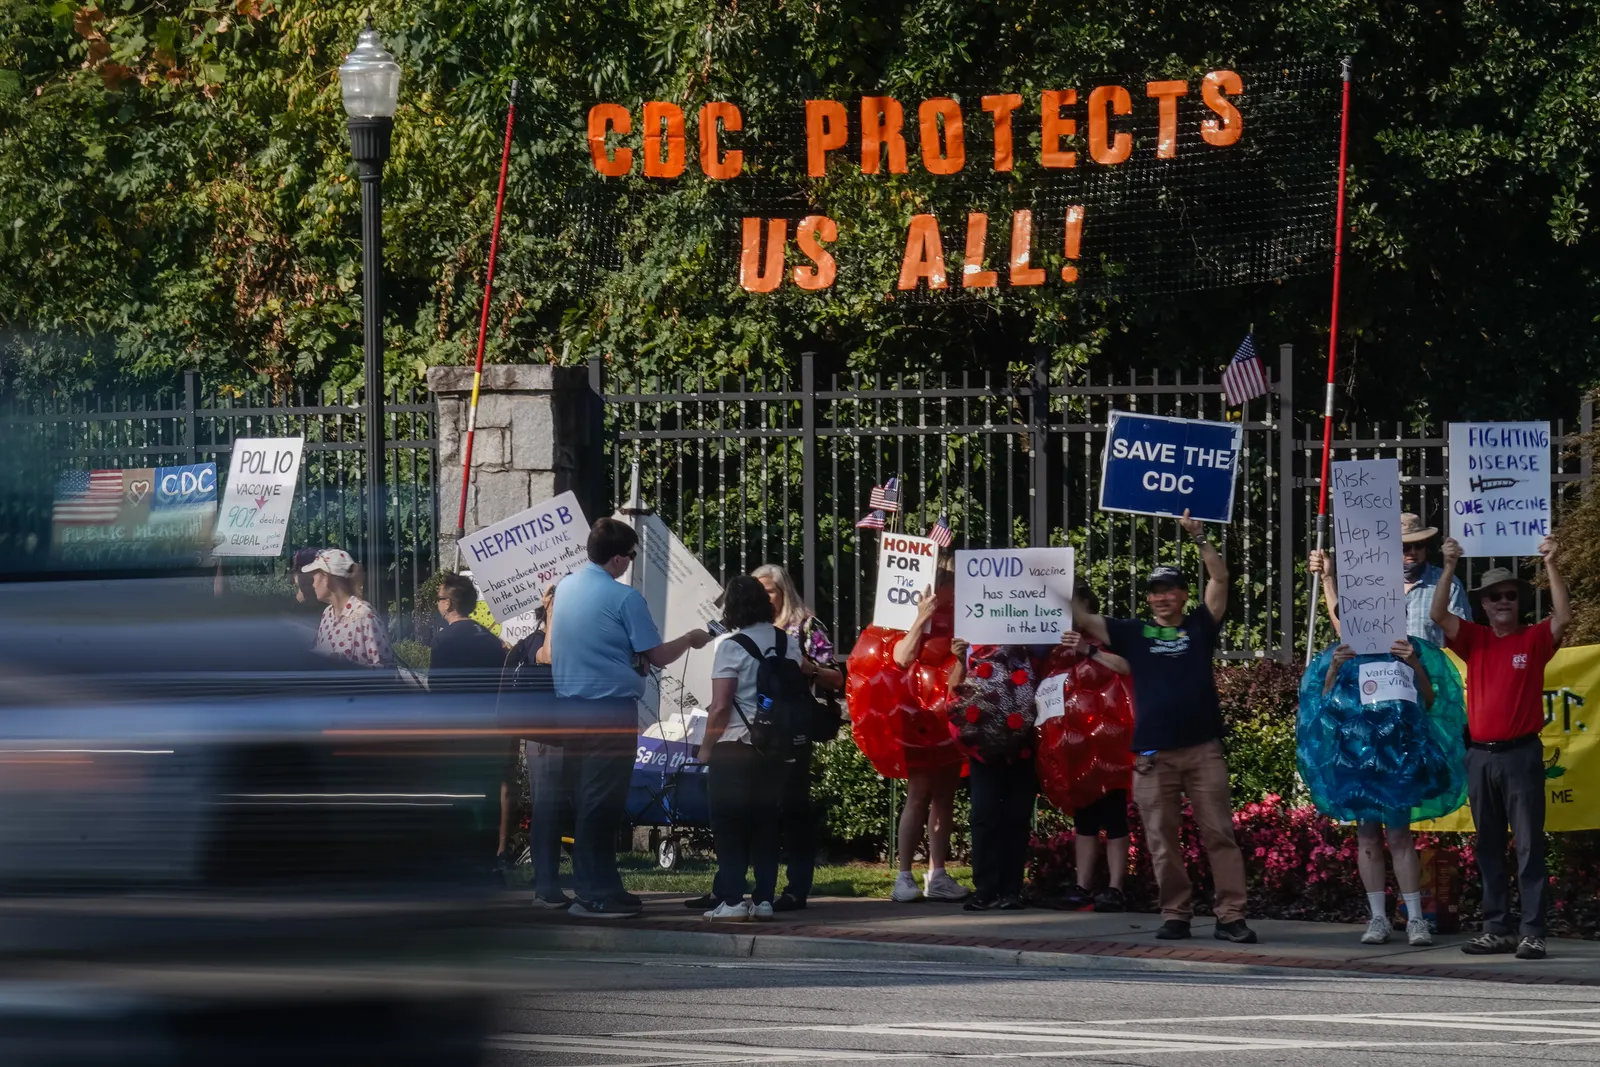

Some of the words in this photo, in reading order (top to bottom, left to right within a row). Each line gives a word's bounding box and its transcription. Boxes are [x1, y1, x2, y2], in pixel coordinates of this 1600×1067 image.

[588, 101, 743, 179] CDC
[805, 70, 1243, 177] PROTECTS
[740, 215, 837, 292] US
[897, 205, 1085, 290] ALL!
[1469, 427, 1548, 448] FIGHTING
[240, 450, 293, 474] POLIO
[1113, 438, 1177, 464] SAVE
[1184, 446, 1231, 469] THE
[1469, 454, 1540, 471] DISEASE
[161, 468, 214, 495] CDC
[236, 483, 282, 496] VACCINE
[1142, 471, 1195, 494] CDC
[1342, 487, 1393, 508] Based
[1454, 498, 1484, 515] ONE
[1487, 496, 1548, 512] VACCINE
[229, 506, 257, 528] 90%
[259, 513, 285, 525] decline
[470, 513, 555, 562] HEPATITIS
[555, 505, 573, 525] B
[1338, 518, 1370, 547] Hep
[1376, 520, 1390, 540] B
[1463, 522, 1486, 537] AT
[1496, 520, 1507, 536] A
[1509, 519, 1548, 536] TIME
[230, 533, 261, 546] GLOBAL
[526, 531, 572, 555] VACCINE
[884, 537, 933, 557] HONK
[887, 555, 920, 572] FOR
[967, 557, 1023, 577] COVID
[1029, 567, 1066, 577] vaccine
[1343, 546, 1389, 570] Birth
[487, 580, 507, 592] has
[507, 562, 539, 584] reduced
[540, 556, 557, 569] new
[894, 575, 914, 587] The
[1341, 574, 1385, 589] Dose
[492, 596, 502, 604] in
[501, 590, 513, 600] the
[526, 580, 536, 590] by
[983, 584, 1003, 599] has
[1009, 585, 1046, 599] saved
[1340, 588, 1400, 614] Doesn't
[502, 595, 540, 616] cirrhosis
[965, 603, 984, 618] >3
[990, 603, 1028, 617] million
[506, 625, 538, 637] NORM
[1007, 624, 1016, 633] in
[1019, 621, 1037, 633] the
[1041, 621, 1060, 633] U.S.
[635, 746, 668, 766] Save
[669, 752, 693, 769] the
[1552, 789, 1574, 804] ME
